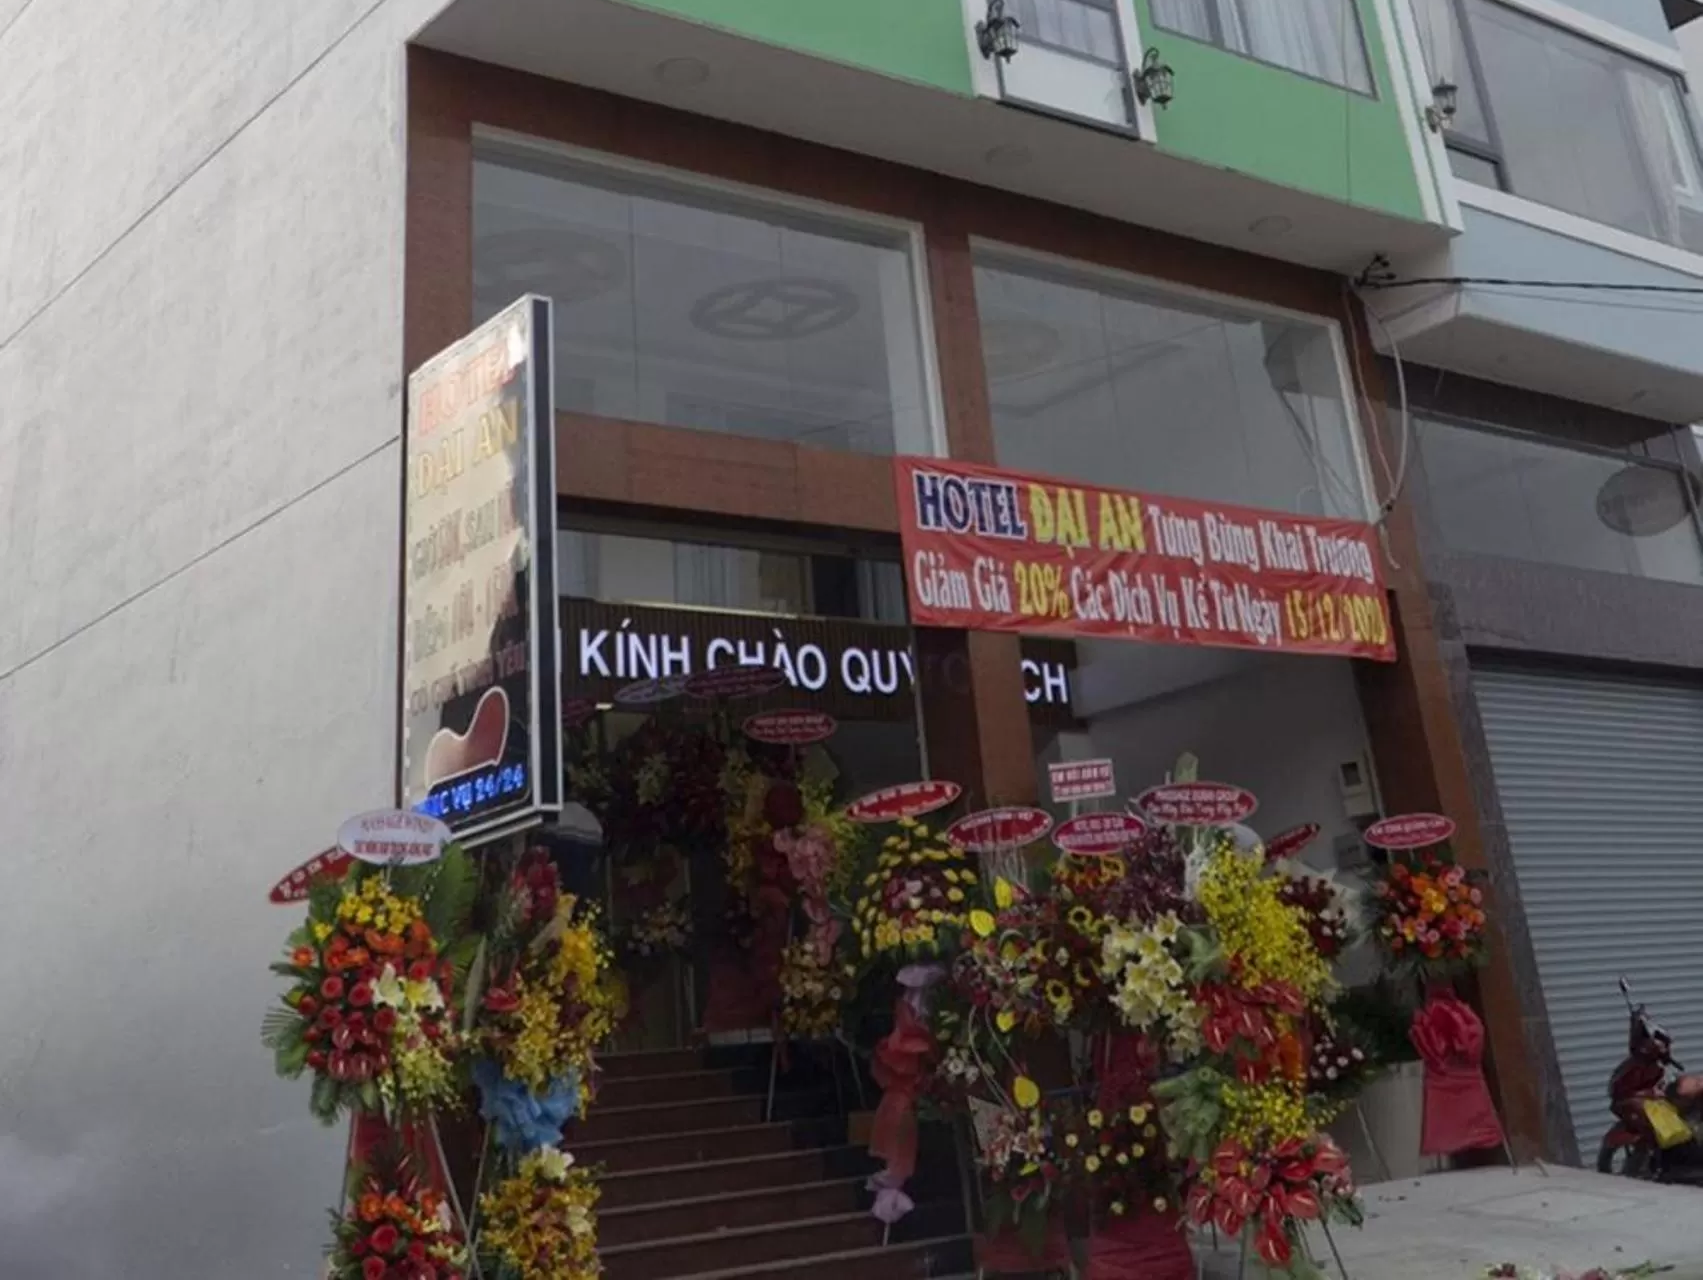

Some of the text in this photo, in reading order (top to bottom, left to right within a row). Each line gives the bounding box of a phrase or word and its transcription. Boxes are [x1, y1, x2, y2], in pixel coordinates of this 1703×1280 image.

[472, 396, 519, 468] AN
[912, 470, 1027, 541] HOTEL
[1100, 492, 1146, 553] AN
[1258, 519, 1308, 572] Khai
[914, 550, 972, 609] Giảm
[973, 556, 1012, 613] Giá
[1013, 560, 1072, 618] 20%
[1071, 566, 1109, 621] Các
[1108, 569, 1154, 636] Dịch
[1152, 572, 1180, 639] Vụ
[580, 618, 690, 678] KÍNH
[706, 628, 828, 691] CHÀO
